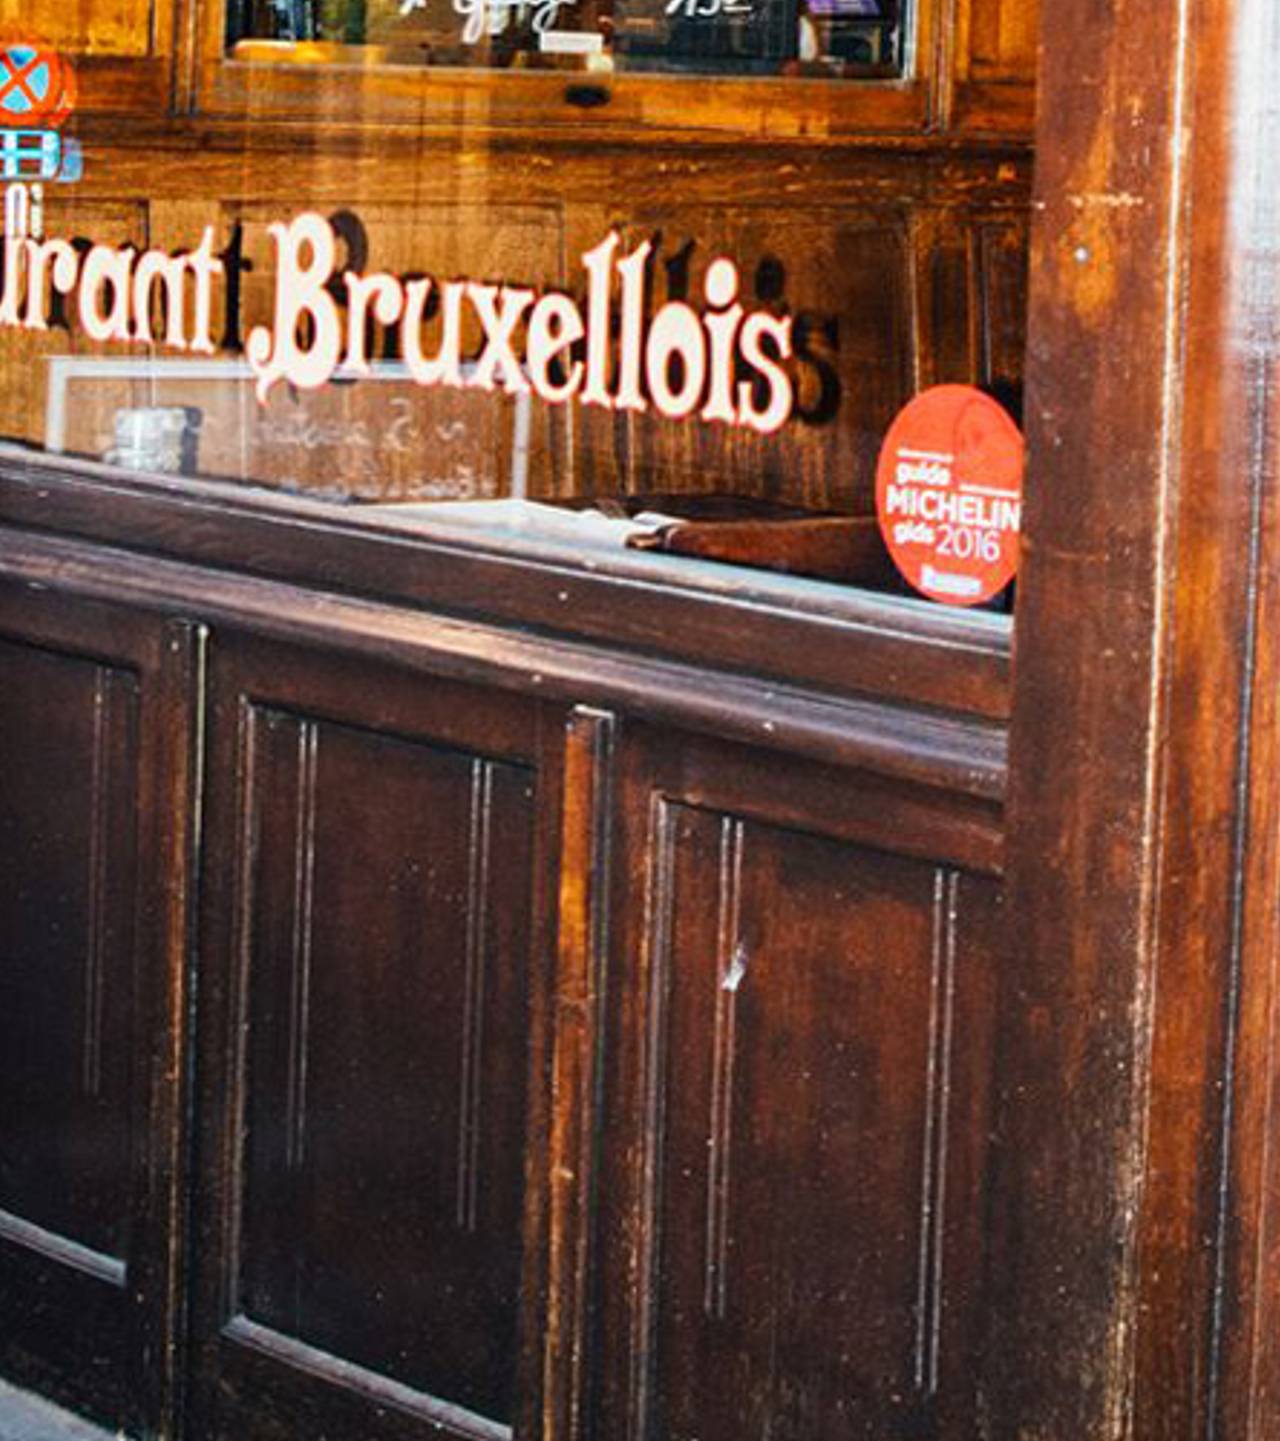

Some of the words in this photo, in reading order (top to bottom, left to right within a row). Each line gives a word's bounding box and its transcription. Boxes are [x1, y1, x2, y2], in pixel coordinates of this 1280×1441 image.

[247, 213, 794, 432] Bruxellois
[896, 462, 950, 485] guide
[886, 484, 1020, 532] MICHELIN
[936, 525, 1000, 562] 2016
